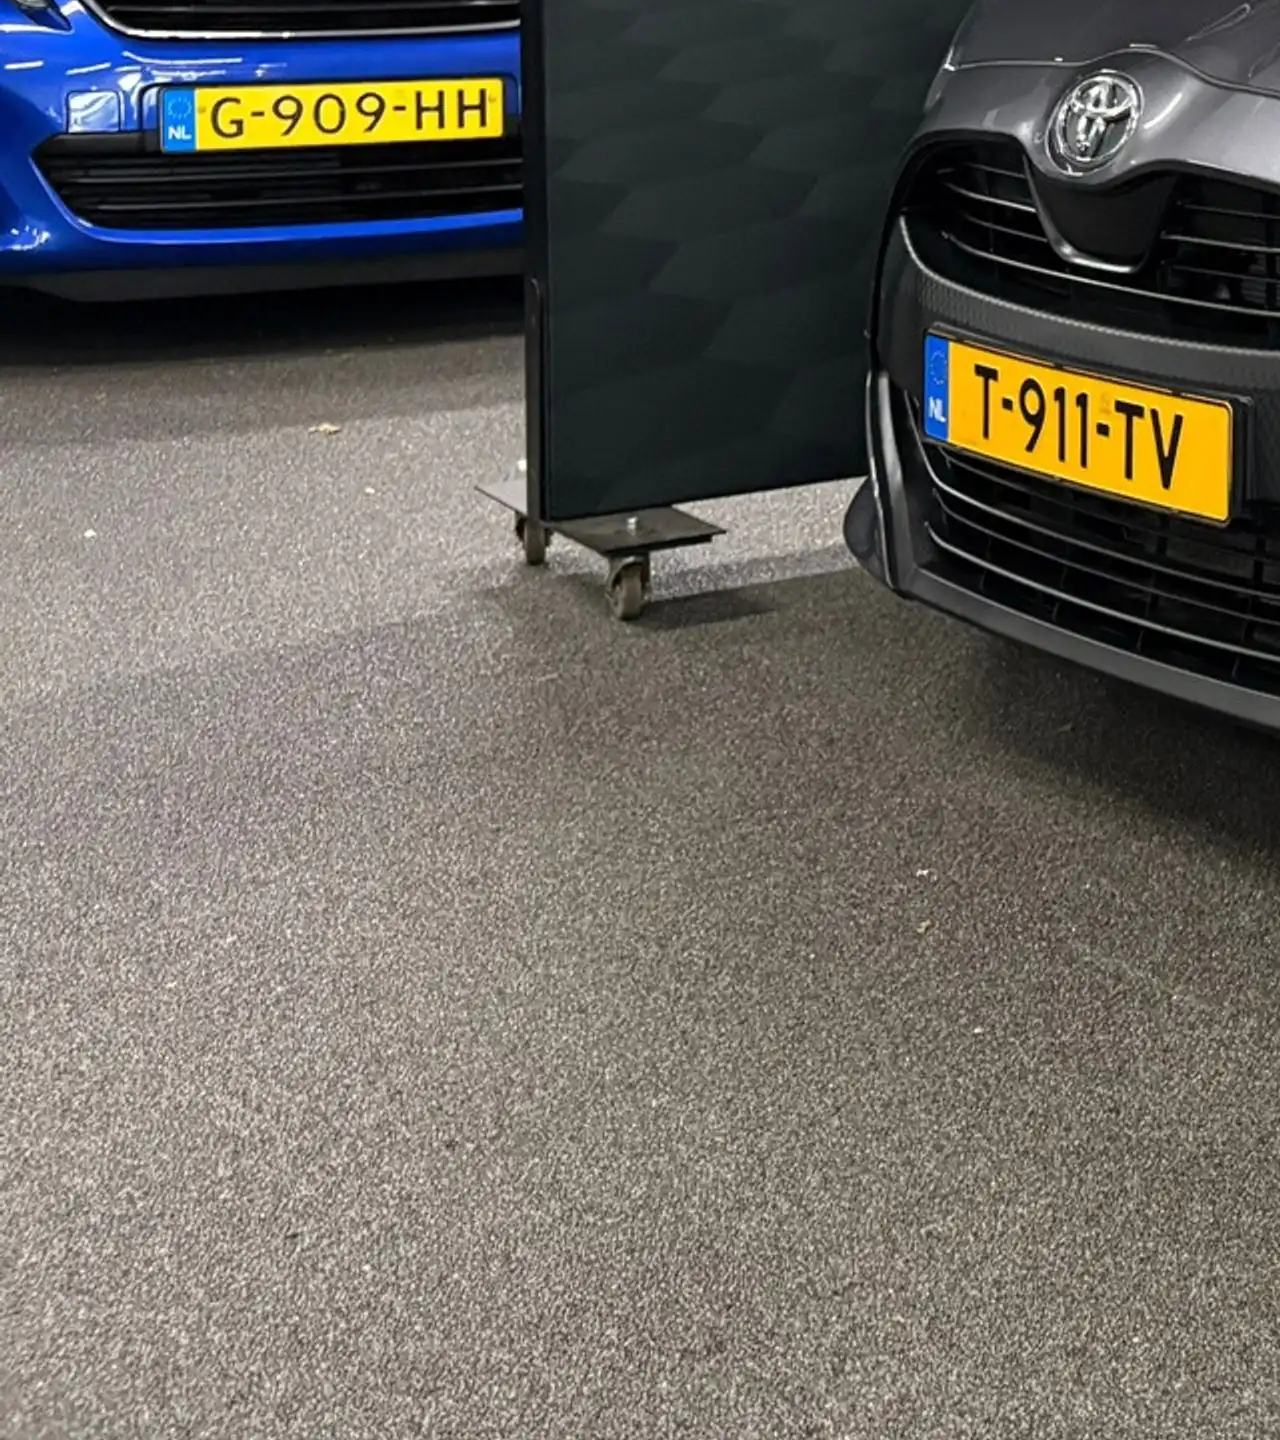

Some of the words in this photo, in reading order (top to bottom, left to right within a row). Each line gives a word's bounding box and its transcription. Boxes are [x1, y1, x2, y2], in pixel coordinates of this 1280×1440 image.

[168, 126, 192, 140] NL
[210, 89, 488, 139] G-909-HH
[928, 396, 947, 423] NL
[974, 364, 1184, 490] T-911-TV
